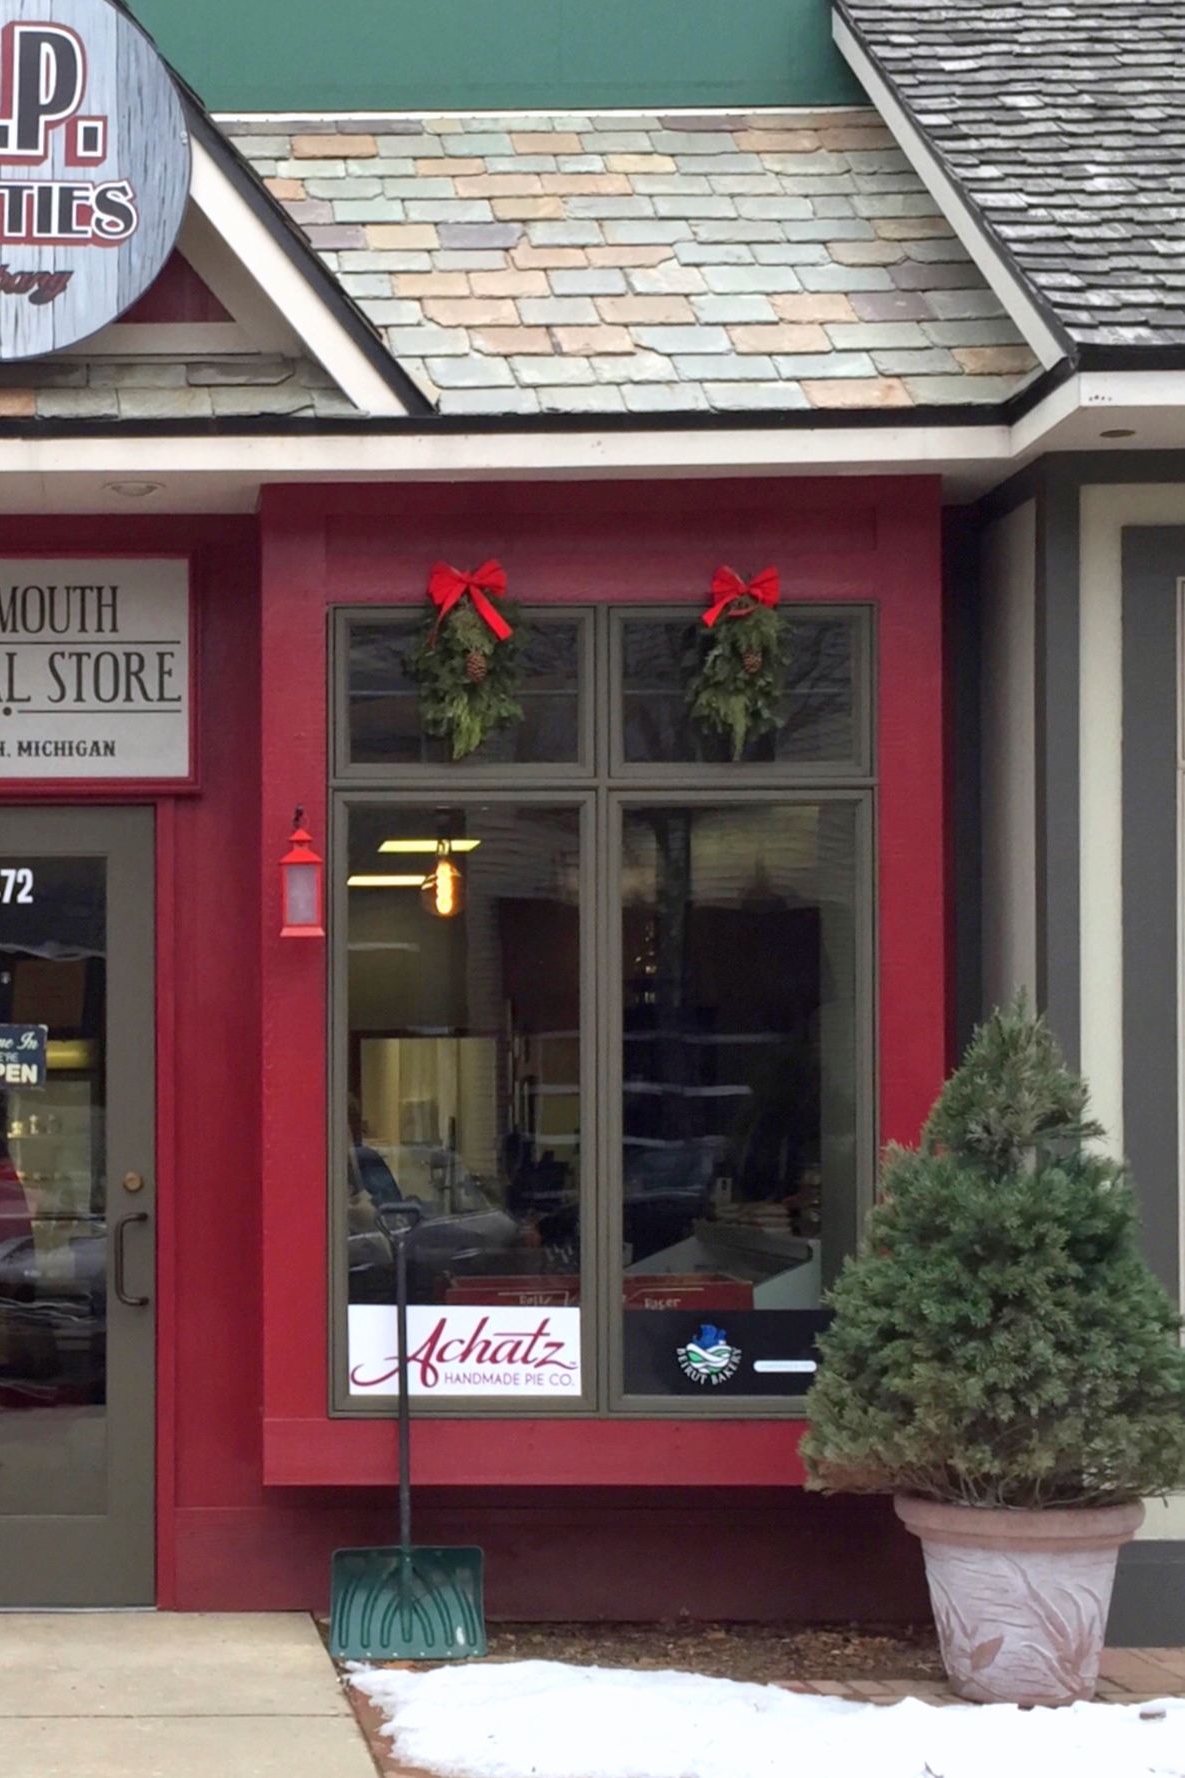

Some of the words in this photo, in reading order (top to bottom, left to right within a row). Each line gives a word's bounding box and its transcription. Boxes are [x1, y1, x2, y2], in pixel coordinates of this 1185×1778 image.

[47, 651, 182, 703] STORE
[17, 740, 116, 758] MICHIGAN
[16, 1031, 39, 1050] In
[349, 1316, 579, 1388] Achatz
[676, 1347, 708, 1385] BEIRUT
[710, 1346, 742, 1385] BAKERY
[444, 1373, 520, 1385] HANDMADE
[524, 1373, 544, 1386] PIE
[548, 1373, 575, 1386] CO.
